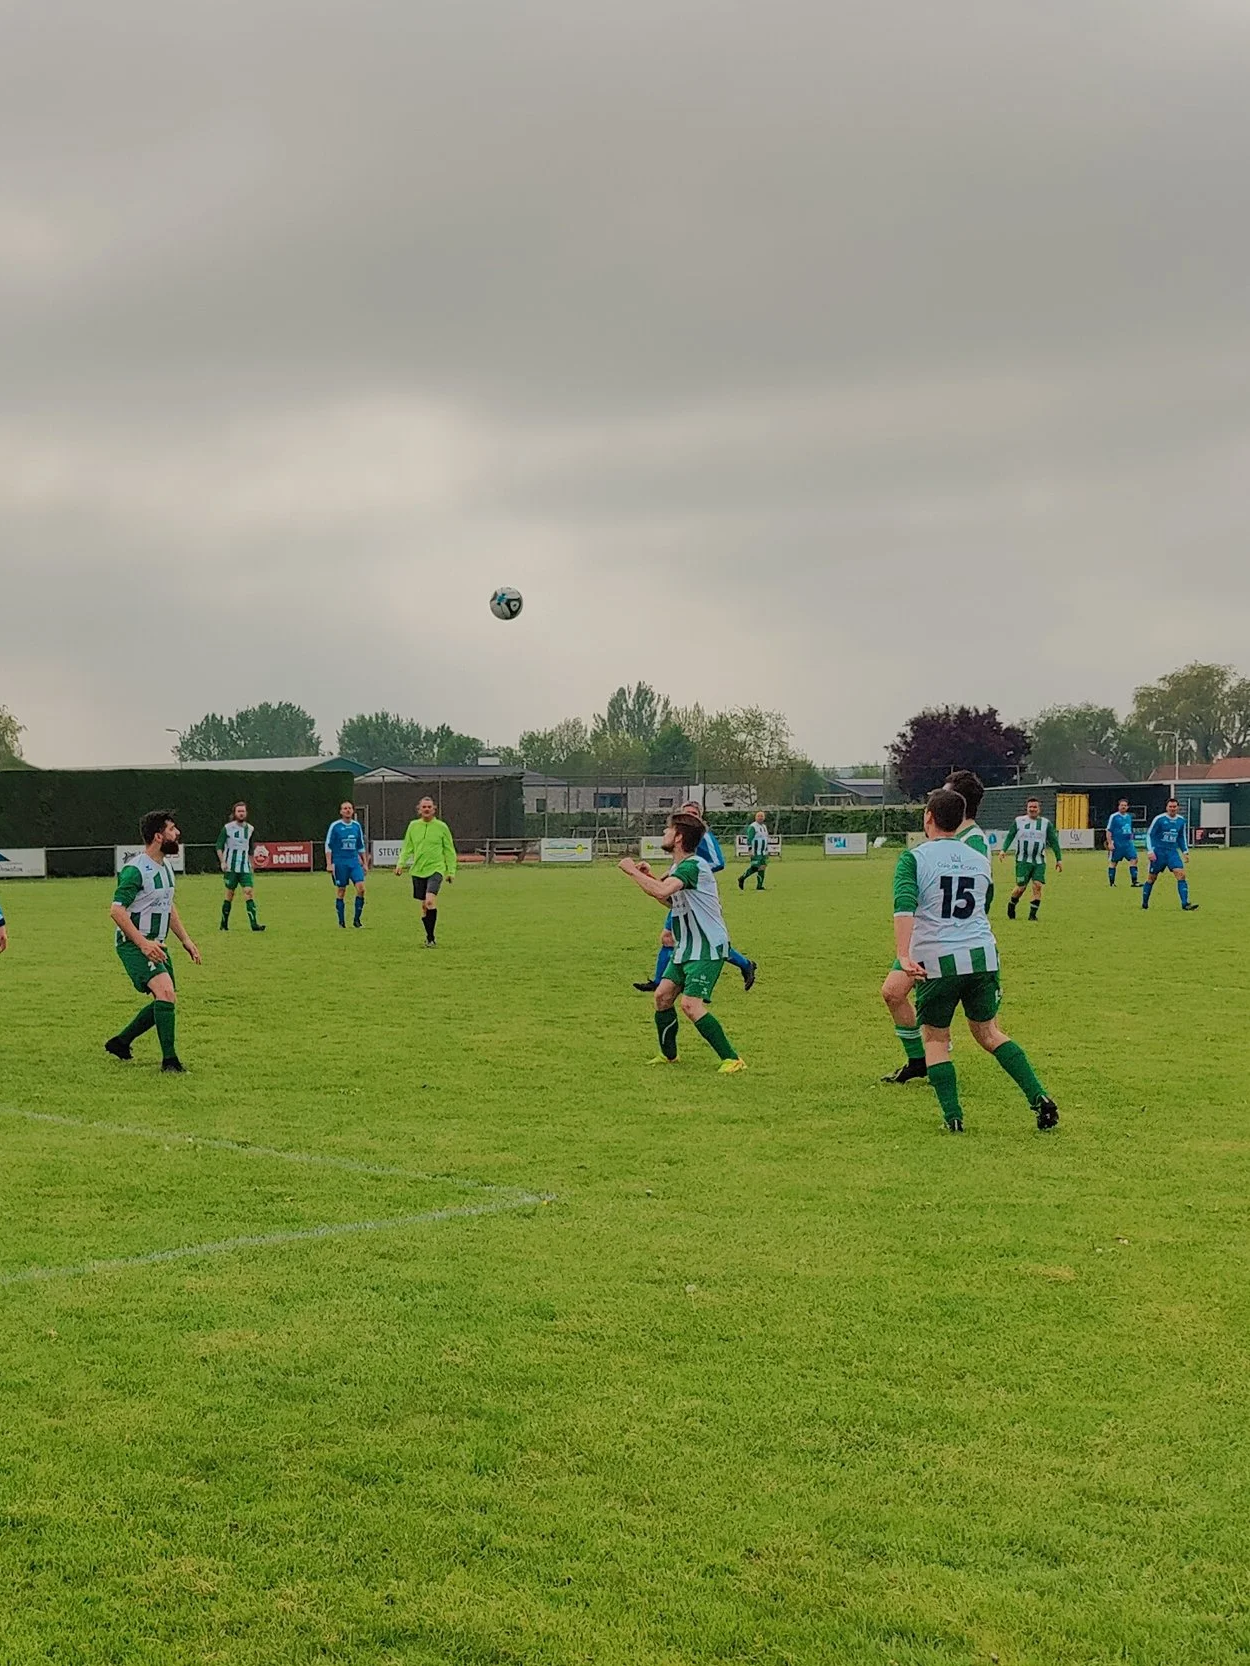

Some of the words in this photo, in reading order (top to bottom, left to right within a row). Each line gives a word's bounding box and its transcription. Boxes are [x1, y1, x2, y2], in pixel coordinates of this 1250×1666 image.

[273, 852, 309, 864] BOËNNE
[378, 847, 402, 857] STEVE
[940, 876, 976, 919] 15
